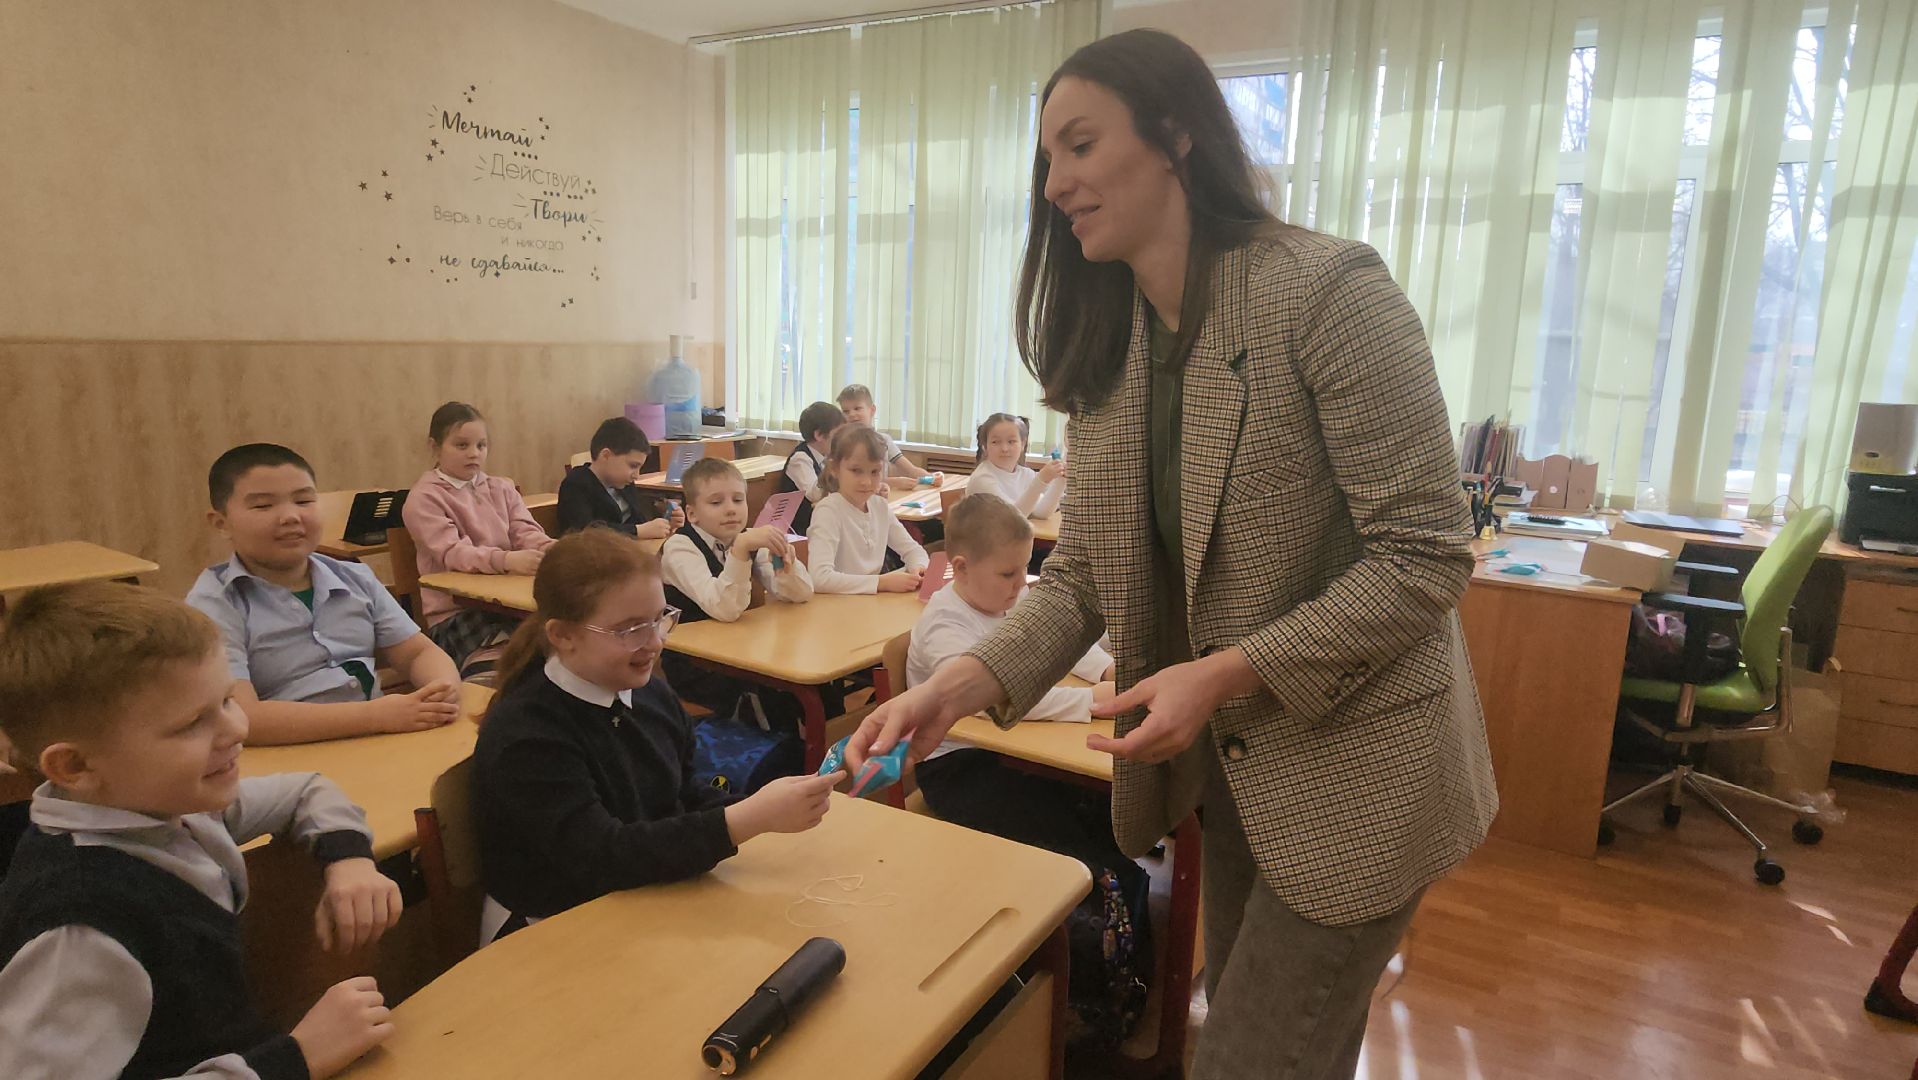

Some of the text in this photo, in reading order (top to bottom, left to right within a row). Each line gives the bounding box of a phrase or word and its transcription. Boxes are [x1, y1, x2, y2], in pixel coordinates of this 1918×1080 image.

[442, 110, 534, 148] Мечтай
[490, 153, 582, 193] Действуй
[433, 205, 470, 225] Верь
[488, 216, 523, 231] себя
[530, 198, 588, 229] Твори
[439, 254, 461, 268] не
